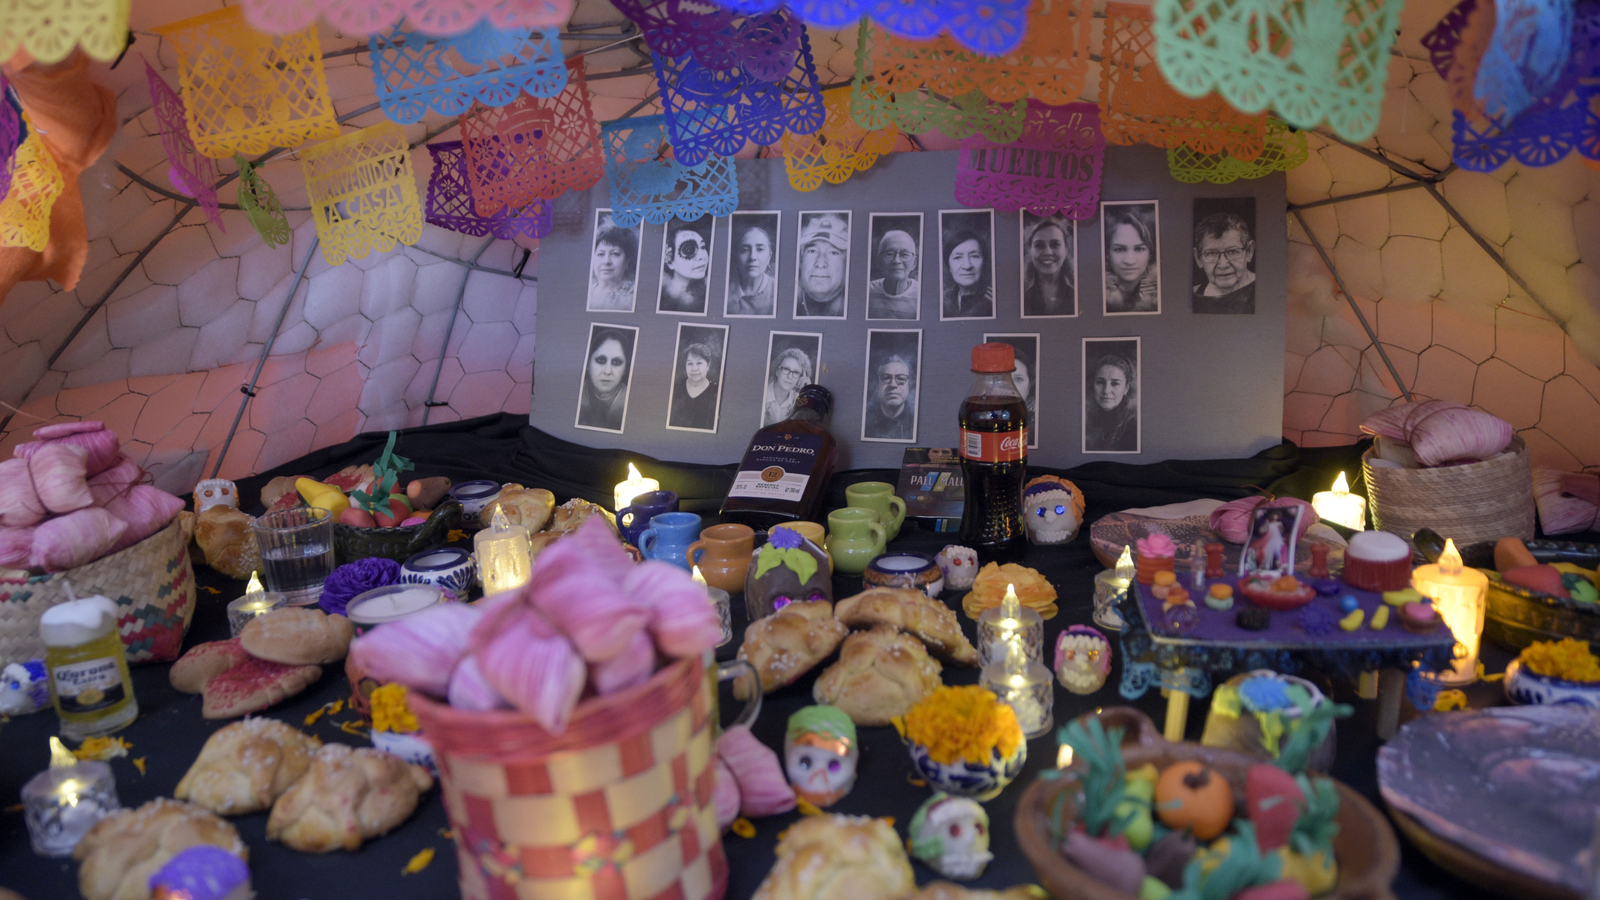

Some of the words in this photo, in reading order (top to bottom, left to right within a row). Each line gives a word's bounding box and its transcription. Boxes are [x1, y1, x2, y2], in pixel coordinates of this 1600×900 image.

[966, 147, 1095, 182] MUERTOS
[311, 155, 406, 203] BIENVENIDOS
[328, 205, 343, 224] A
[346, 186, 403, 216] CASA
[777, 446, 814, 454] PEDRO
[911, 475, 934, 486] PALL
[940, 476, 965, 487] MALL
[57, 662, 115, 681] Corona
